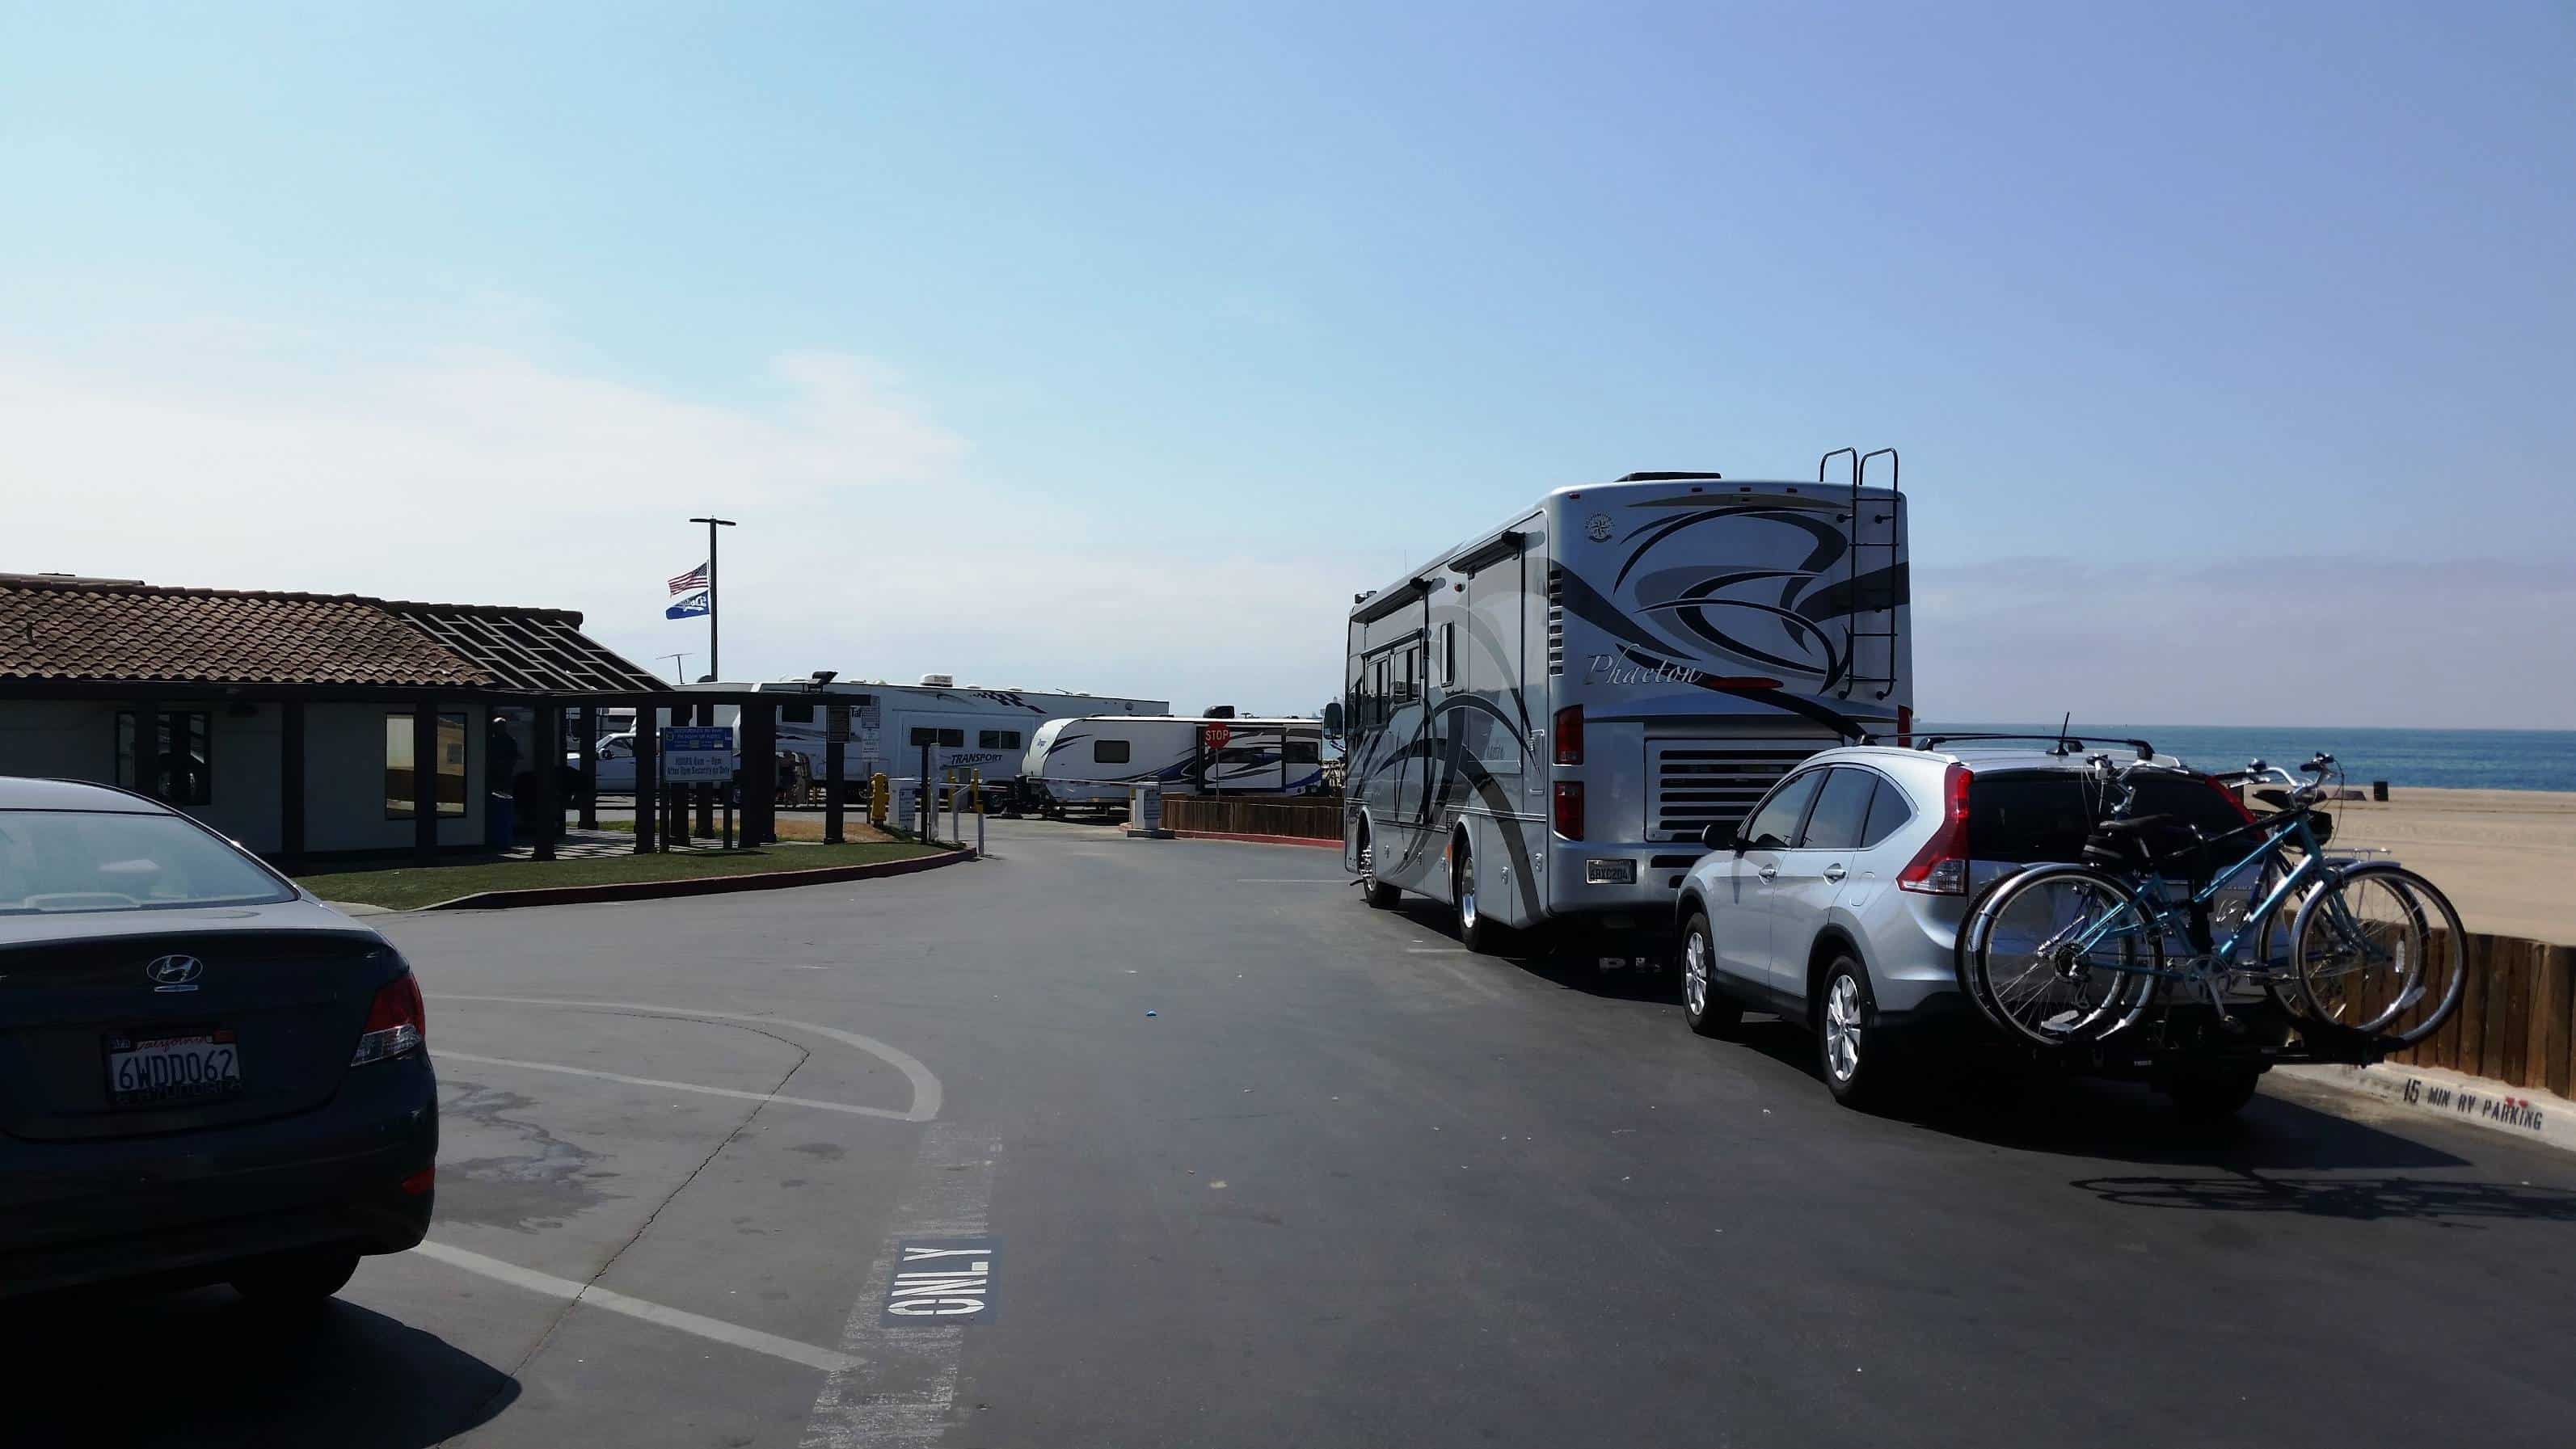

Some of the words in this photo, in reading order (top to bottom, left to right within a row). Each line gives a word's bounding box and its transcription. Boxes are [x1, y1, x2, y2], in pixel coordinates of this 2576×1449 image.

[1584, 643, 1704, 685] Phaeton
[1205, 729, 1229, 741] STOP
[951, 753, 1002, 765] TRANSPORT
[119, 1049, 236, 1089] 6WDD062
[2404, 1078, 2422, 1105] 15
[2427, 1087, 2451, 1108] MIN
[2457, 1094, 2477, 1114] RV
[2482, 1098, 2543, 1131] PARKING
[888, 1247, 992, 1316] ONLY
